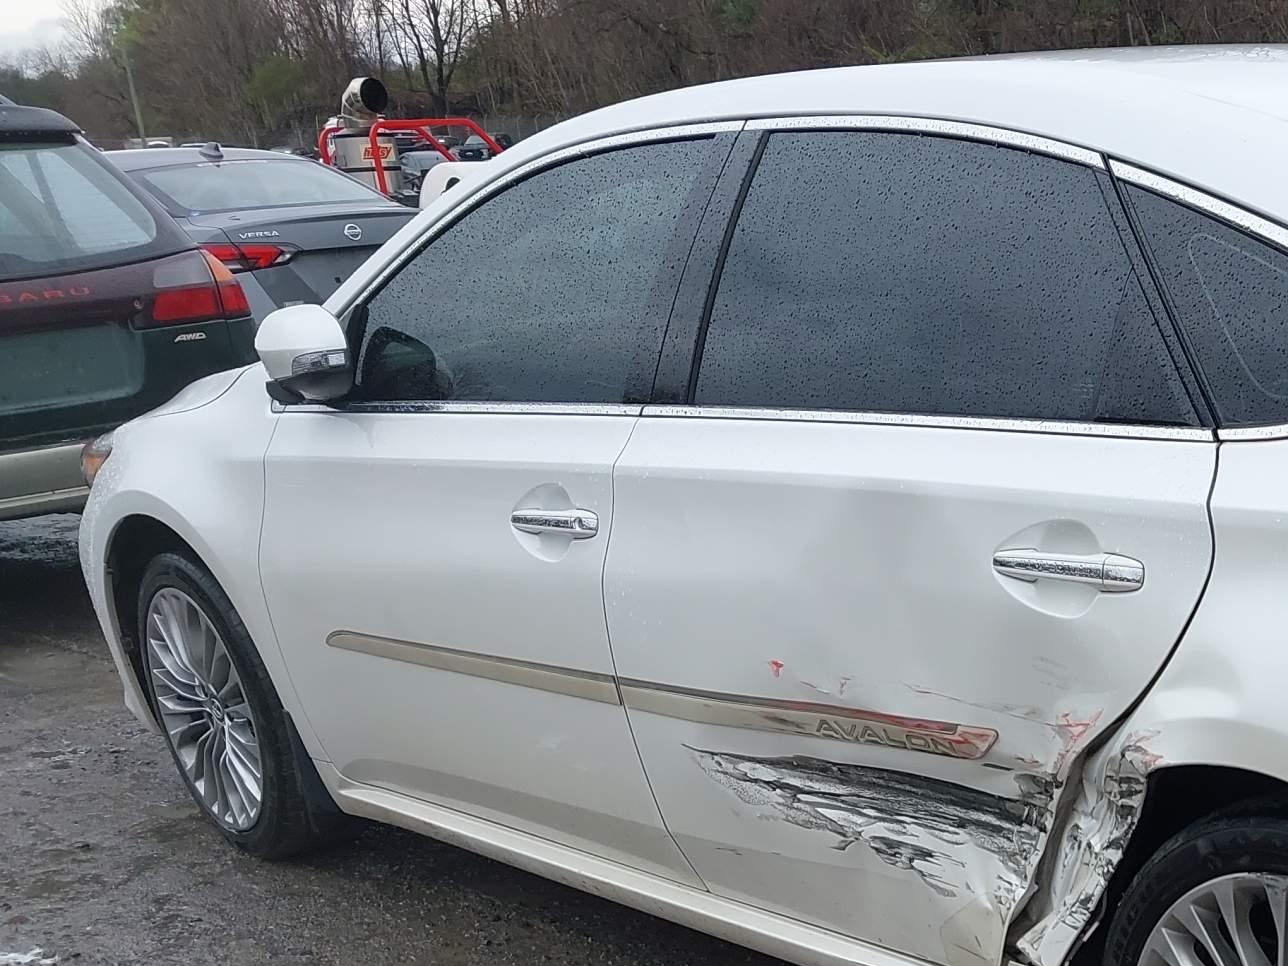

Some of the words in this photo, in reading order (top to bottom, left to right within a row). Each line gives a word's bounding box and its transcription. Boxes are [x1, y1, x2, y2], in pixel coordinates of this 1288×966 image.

[363, 145, 393, 160] hsy
[238, 230, 280, 240] VERSA
[174, 332, 207, 343] AWD
[815, 718, 957, 755] AVALON
